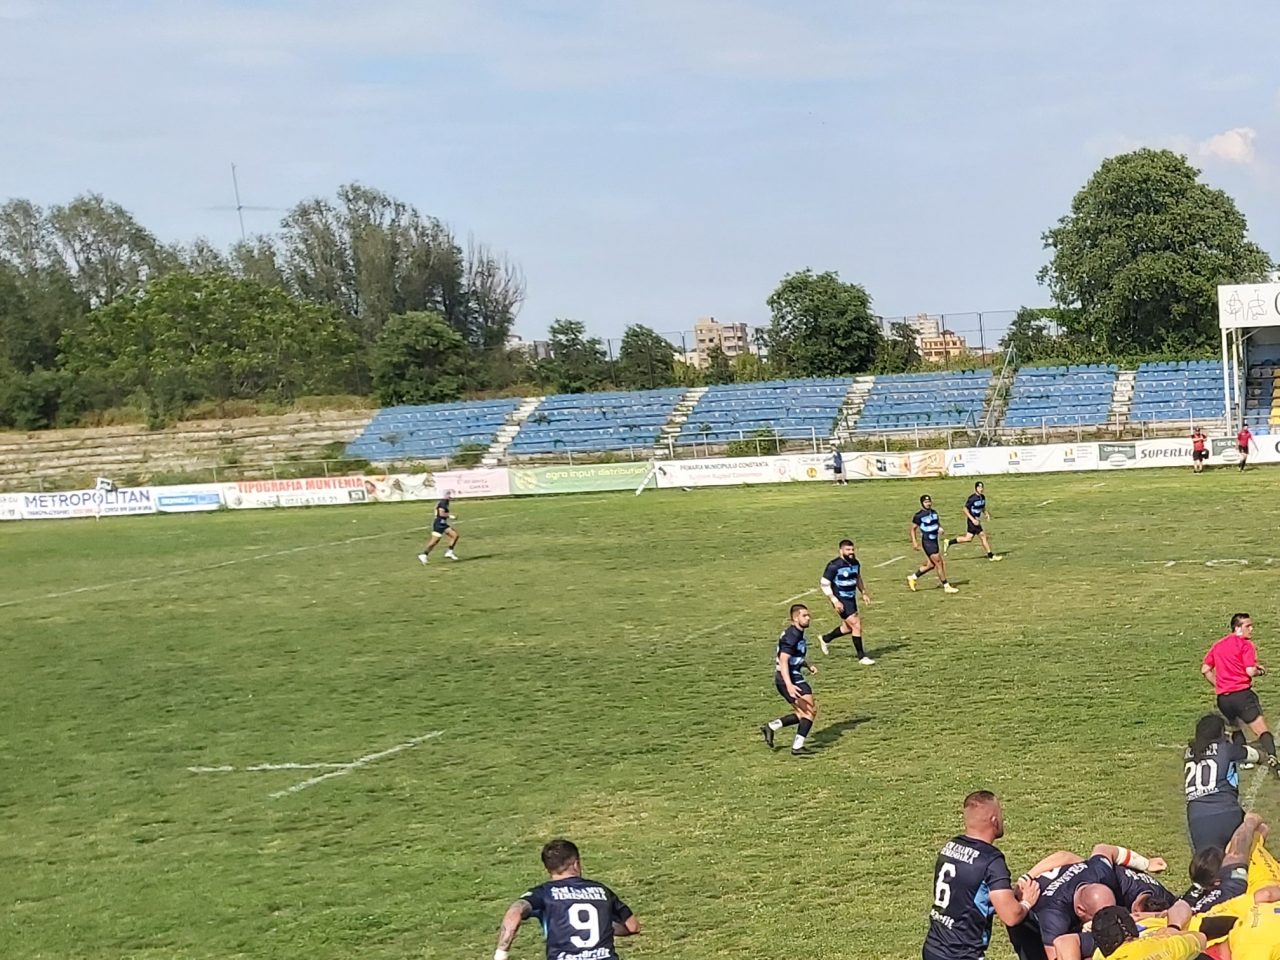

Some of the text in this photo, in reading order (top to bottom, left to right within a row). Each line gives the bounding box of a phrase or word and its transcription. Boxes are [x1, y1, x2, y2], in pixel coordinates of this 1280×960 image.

[1141, 448, 1194, 459] SUPERLIG
[237, 476, 364, 494] TIPOGRAFIA MUNTENIA
[24, 490, 150, 508] METROPOLITAN
[1184, 759, 1218, 794] 20
[934, 862, 956, 909] 6
[568, 903, 600, 948] 9
